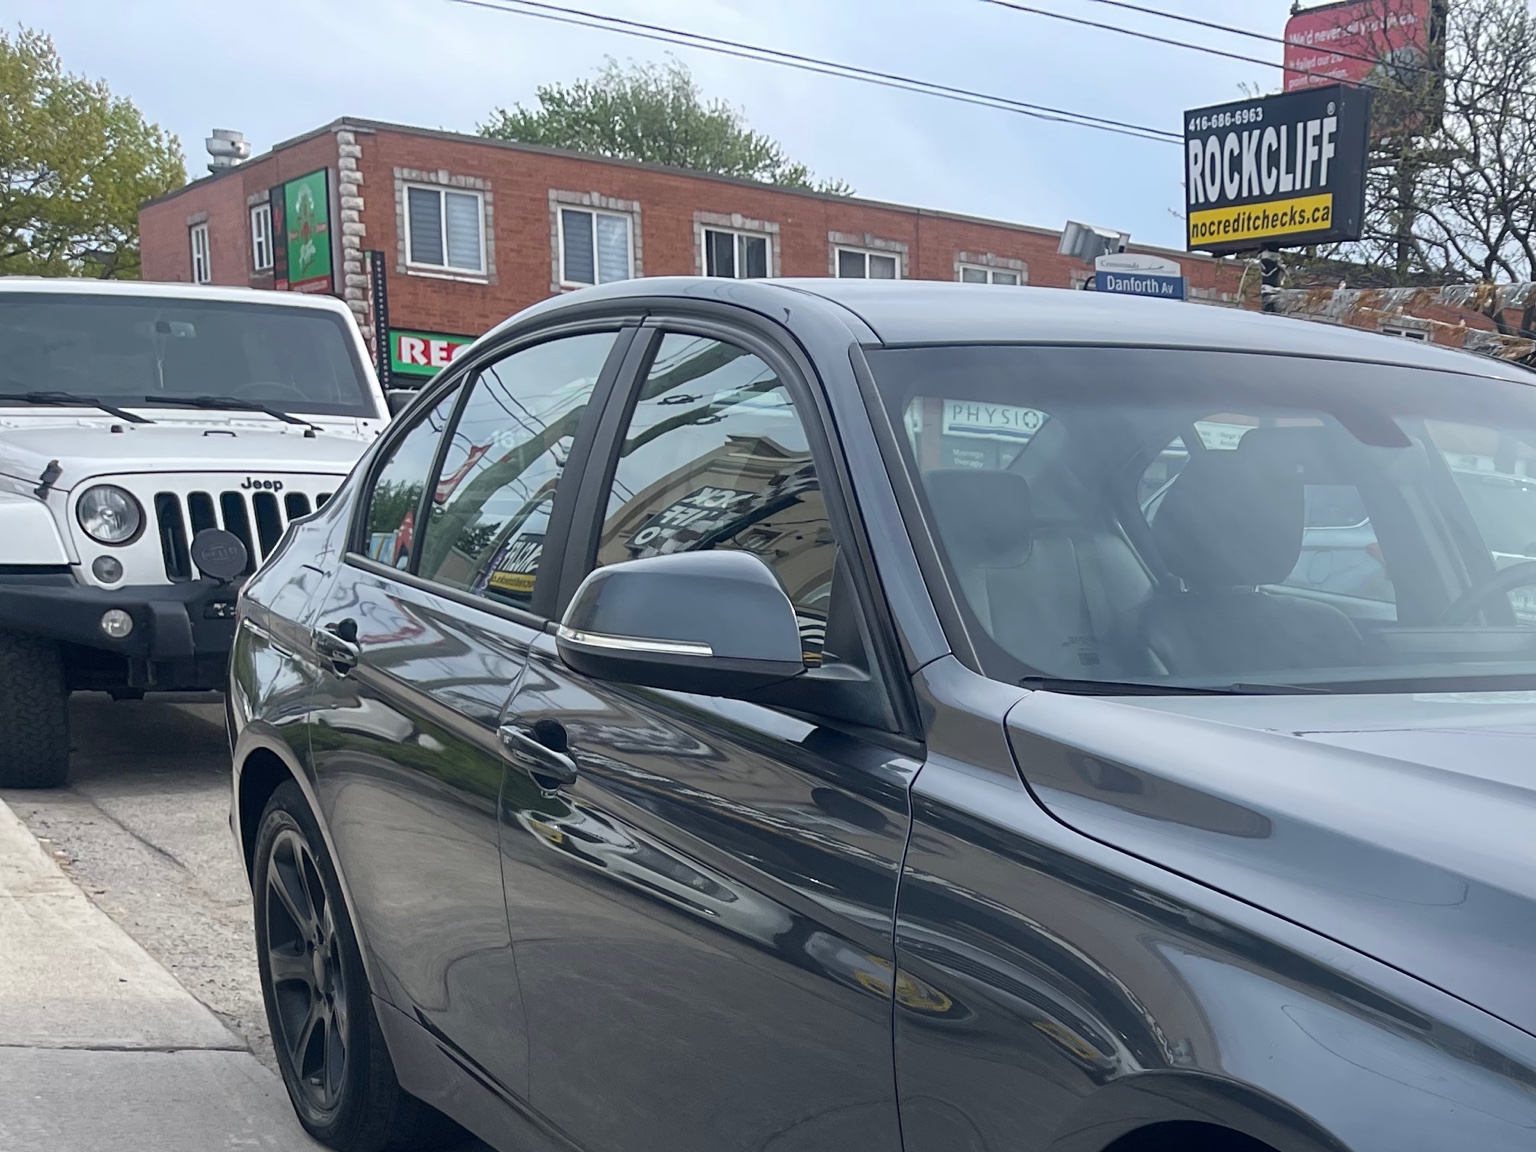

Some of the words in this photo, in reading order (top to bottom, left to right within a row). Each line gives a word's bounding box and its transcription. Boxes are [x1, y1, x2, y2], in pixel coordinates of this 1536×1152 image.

[1188, 107, 1263, 132] 416-686-6963
[1188, 116, 1337, 205] ROCKCLIFF
[1191, 205, 1330, 239] nocreditchecks.ca
[1107, 275, 1159, 293] Danforth
[1161, 282, 1174, 294] Av
[241, 477, 283, 492] Jeep
